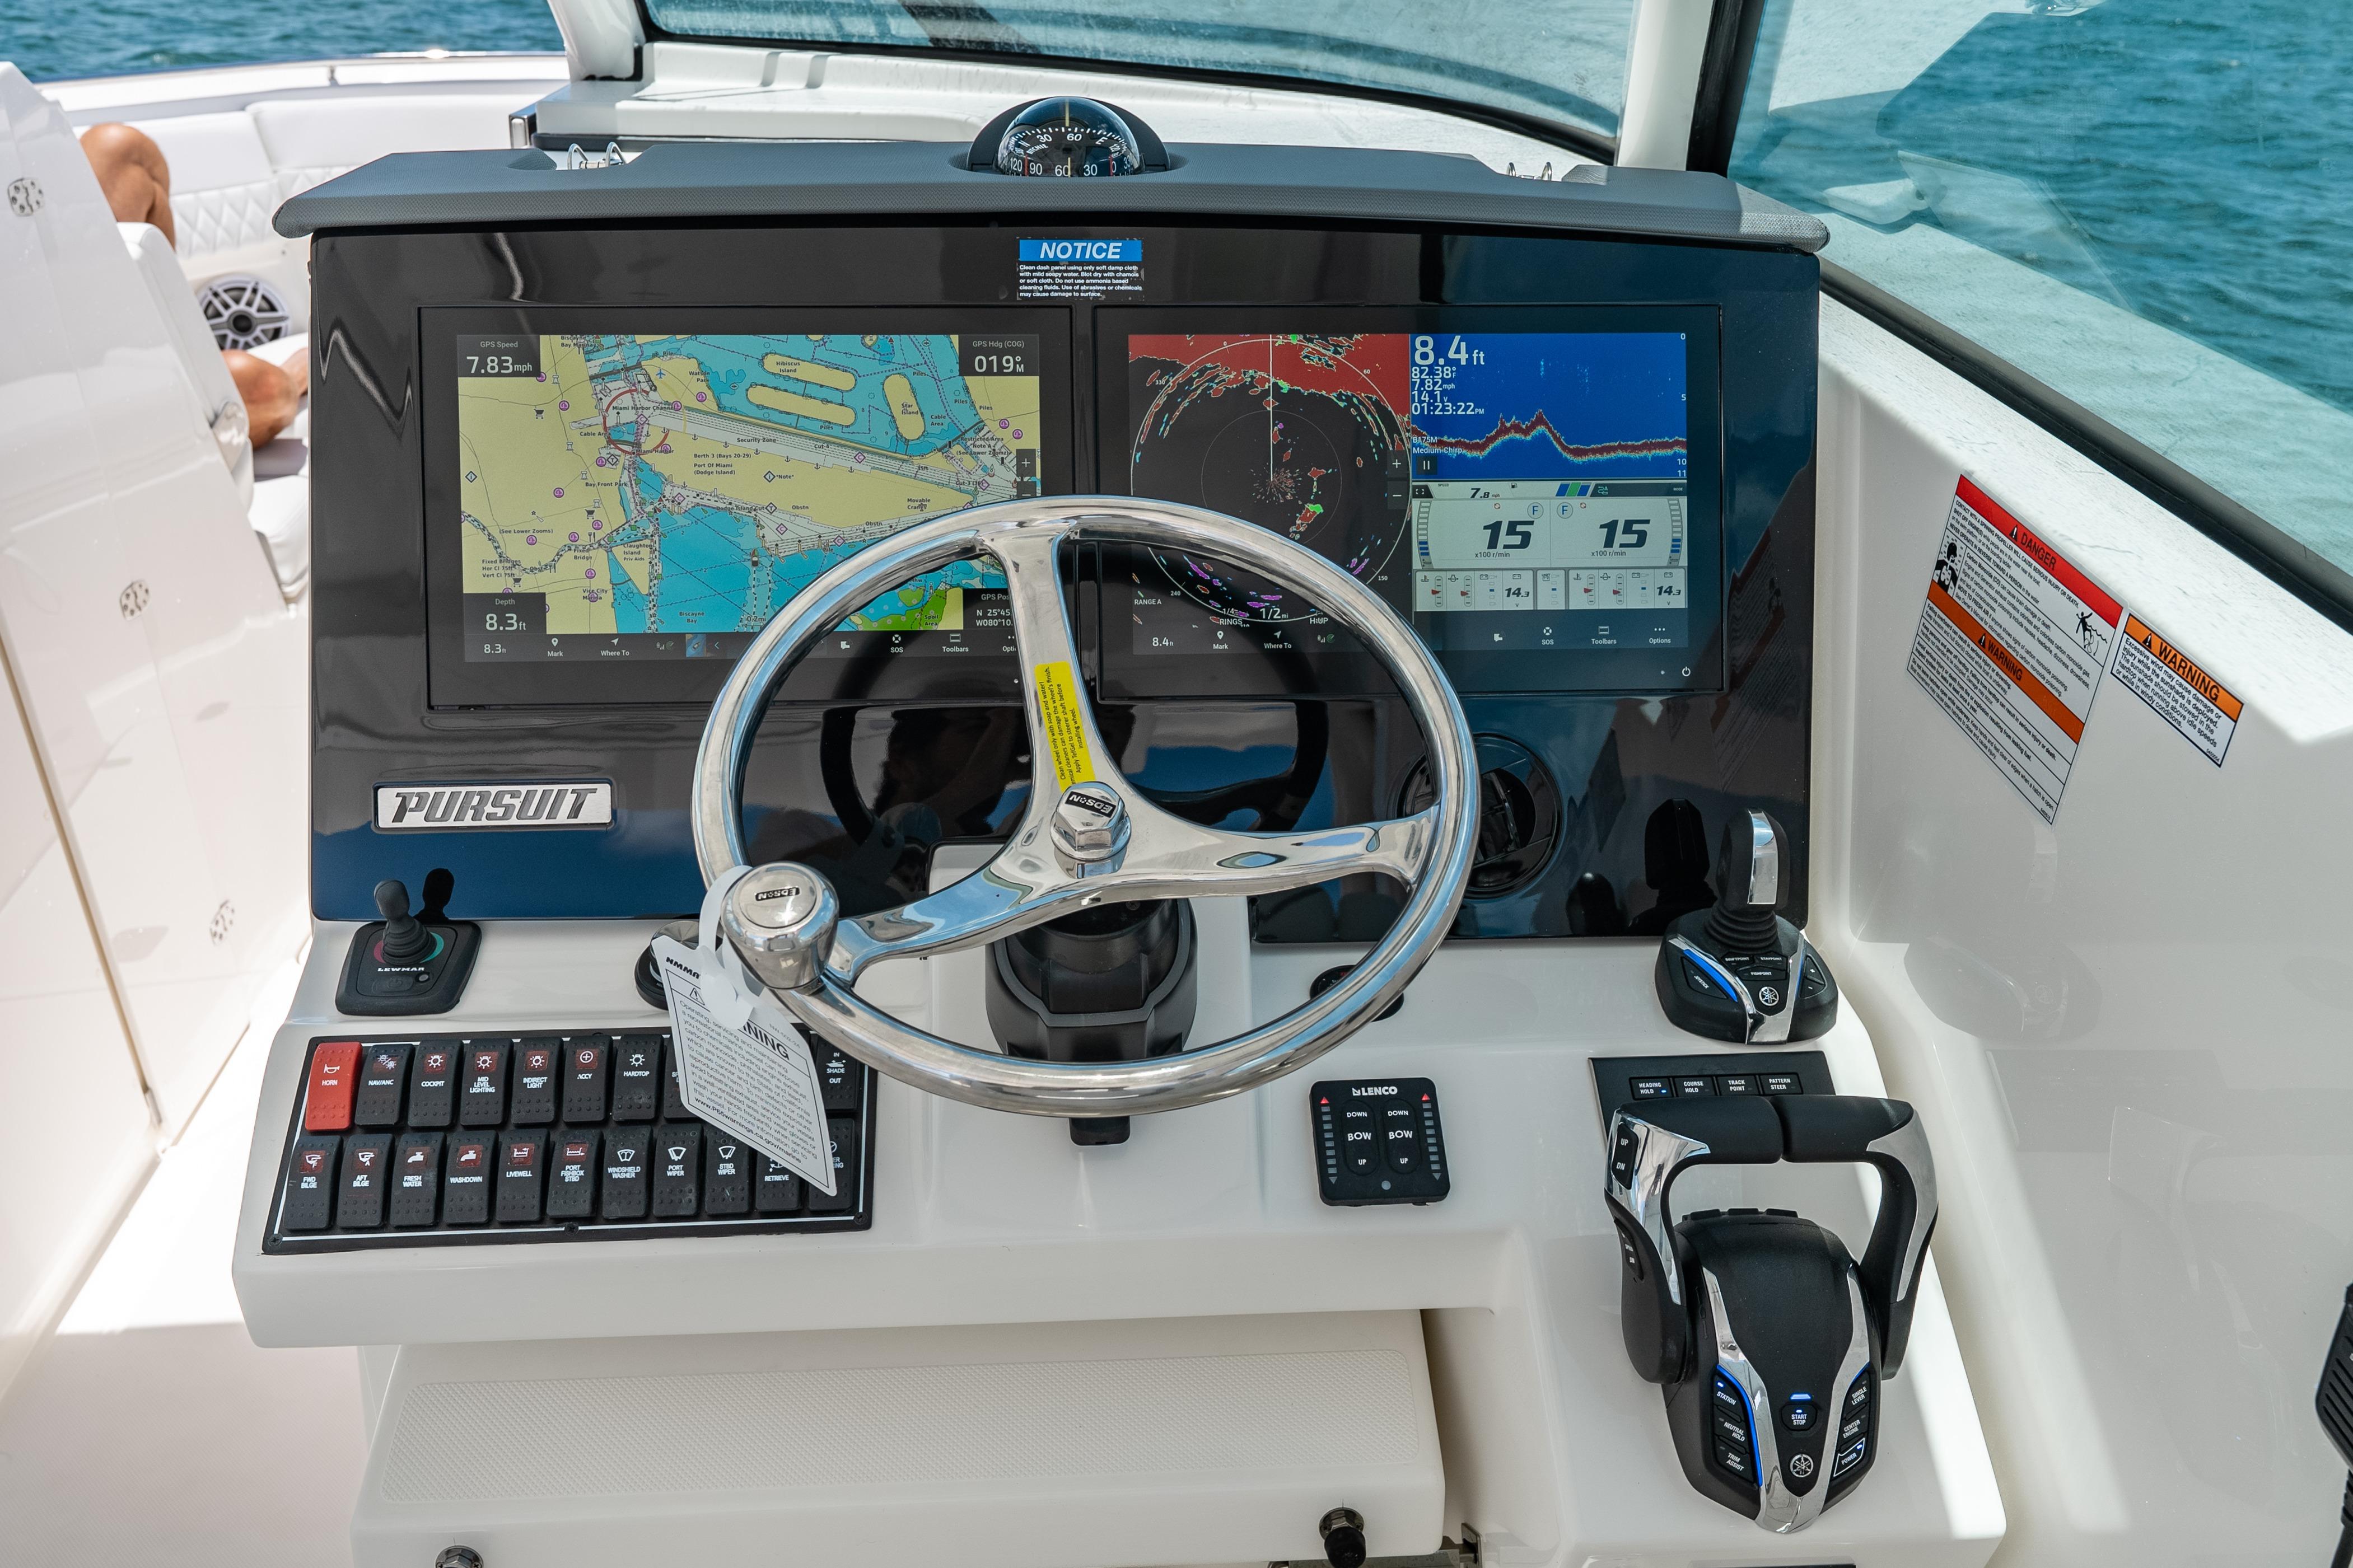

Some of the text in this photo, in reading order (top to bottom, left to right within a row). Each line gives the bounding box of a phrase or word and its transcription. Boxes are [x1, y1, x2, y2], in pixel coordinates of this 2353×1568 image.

[1030, 162, 1043, 175] 90
[1084, 164, 1098, 176] 30
[1040, 242, 1122, 259] NOTICE
[497, 341, 518, 349] Speed
[988, 340, 1002, 349] Hdg
[1473, 349, 1485, 365] ft
[1483, 520, 1534, 550] 15
[1599, 519, 1651, 549] 15
[2021, 532, 2057, 570] DANGER
[1987, 638, 2023, 682] WARNING
[2125, 637, 2221, 720] Excessive wind may cause damage or
[2159, 642, 2220, 703] WARNING
[391, 788, 597, 823] PURSUIT
[1069, 794, 1114, 813] EDSON
[743, 1022, 790, 1060] NING
[1362, 1086, 1398, 1096] LENCO
[1347, 1132, 1371, 1141] BOW
[1389, 1130, 1412, 1139] BOW
[1717, 1391, 1736, 1405] STATION
[1841, 1452, 1857, 1466] POWER
